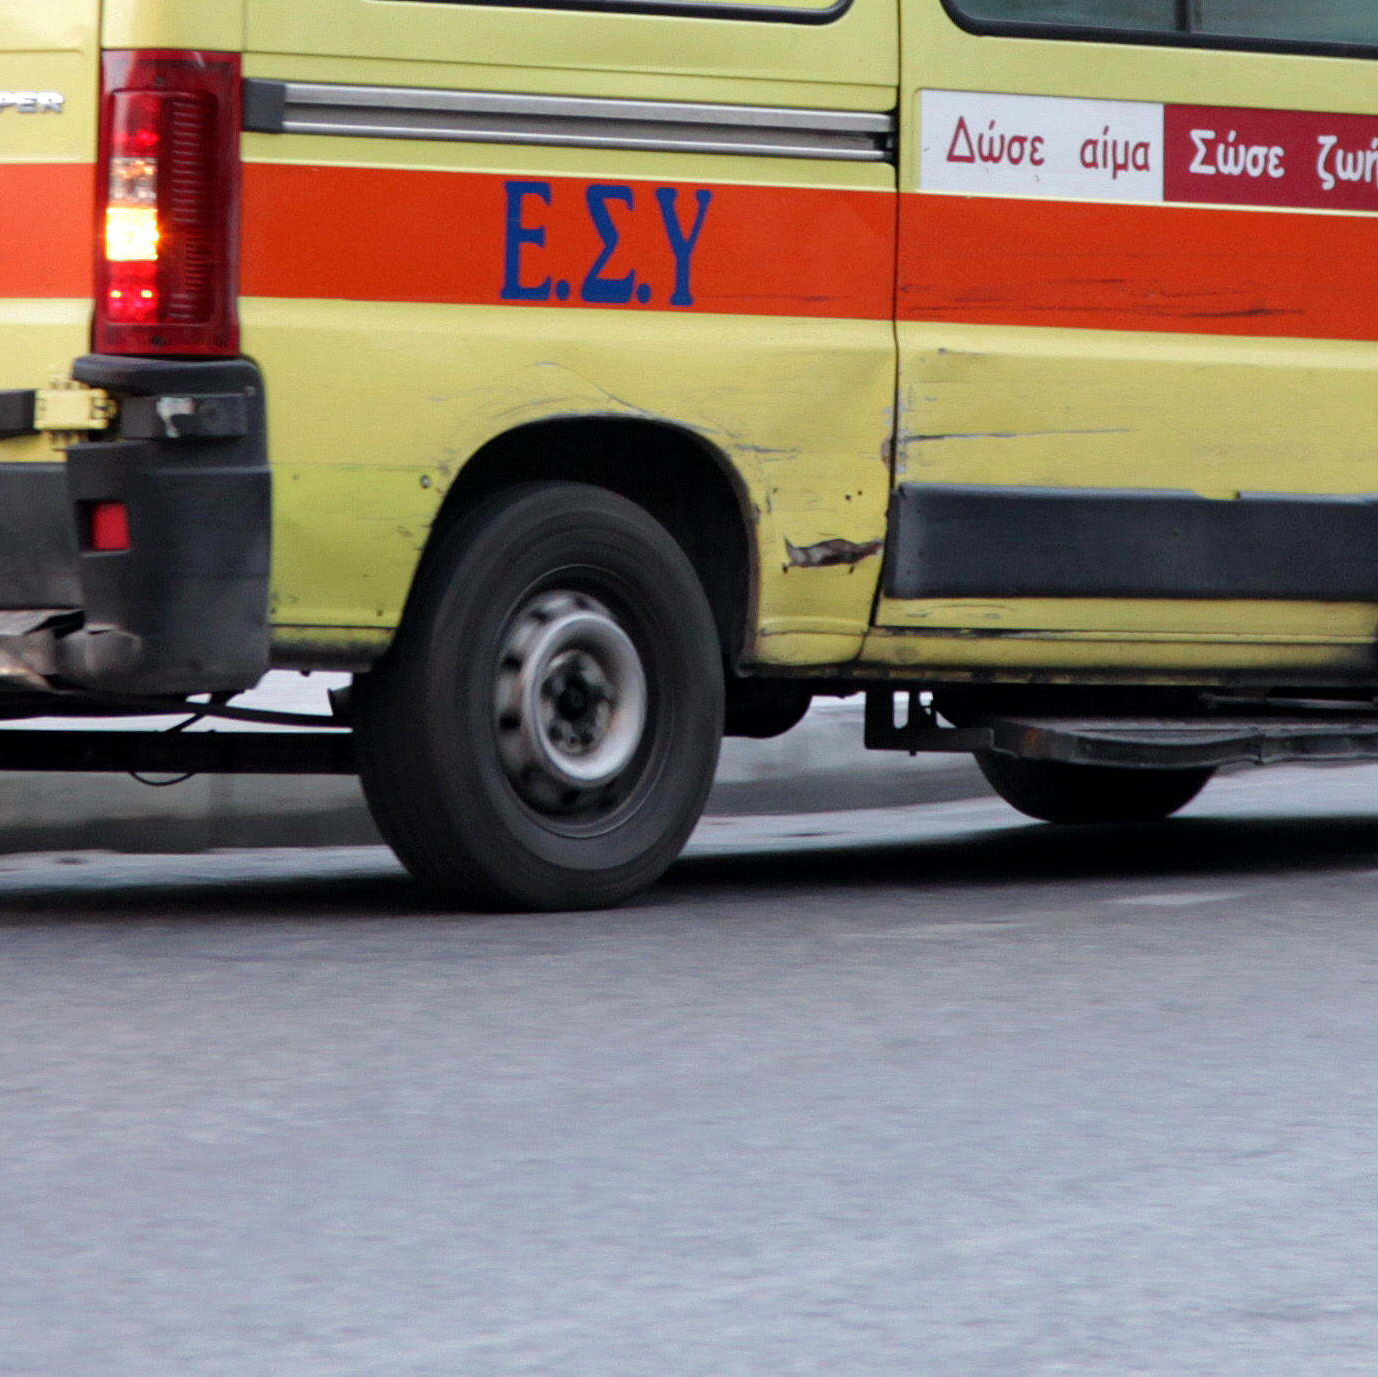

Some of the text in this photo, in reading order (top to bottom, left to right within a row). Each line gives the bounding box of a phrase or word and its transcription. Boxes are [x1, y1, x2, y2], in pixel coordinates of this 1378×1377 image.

[945, 113, 1152, 181] Δώσε αίμα
[1188, 127, 1285, 180] Σώσε
[499, 180, 714, 307] Ε.Σ.Υ
